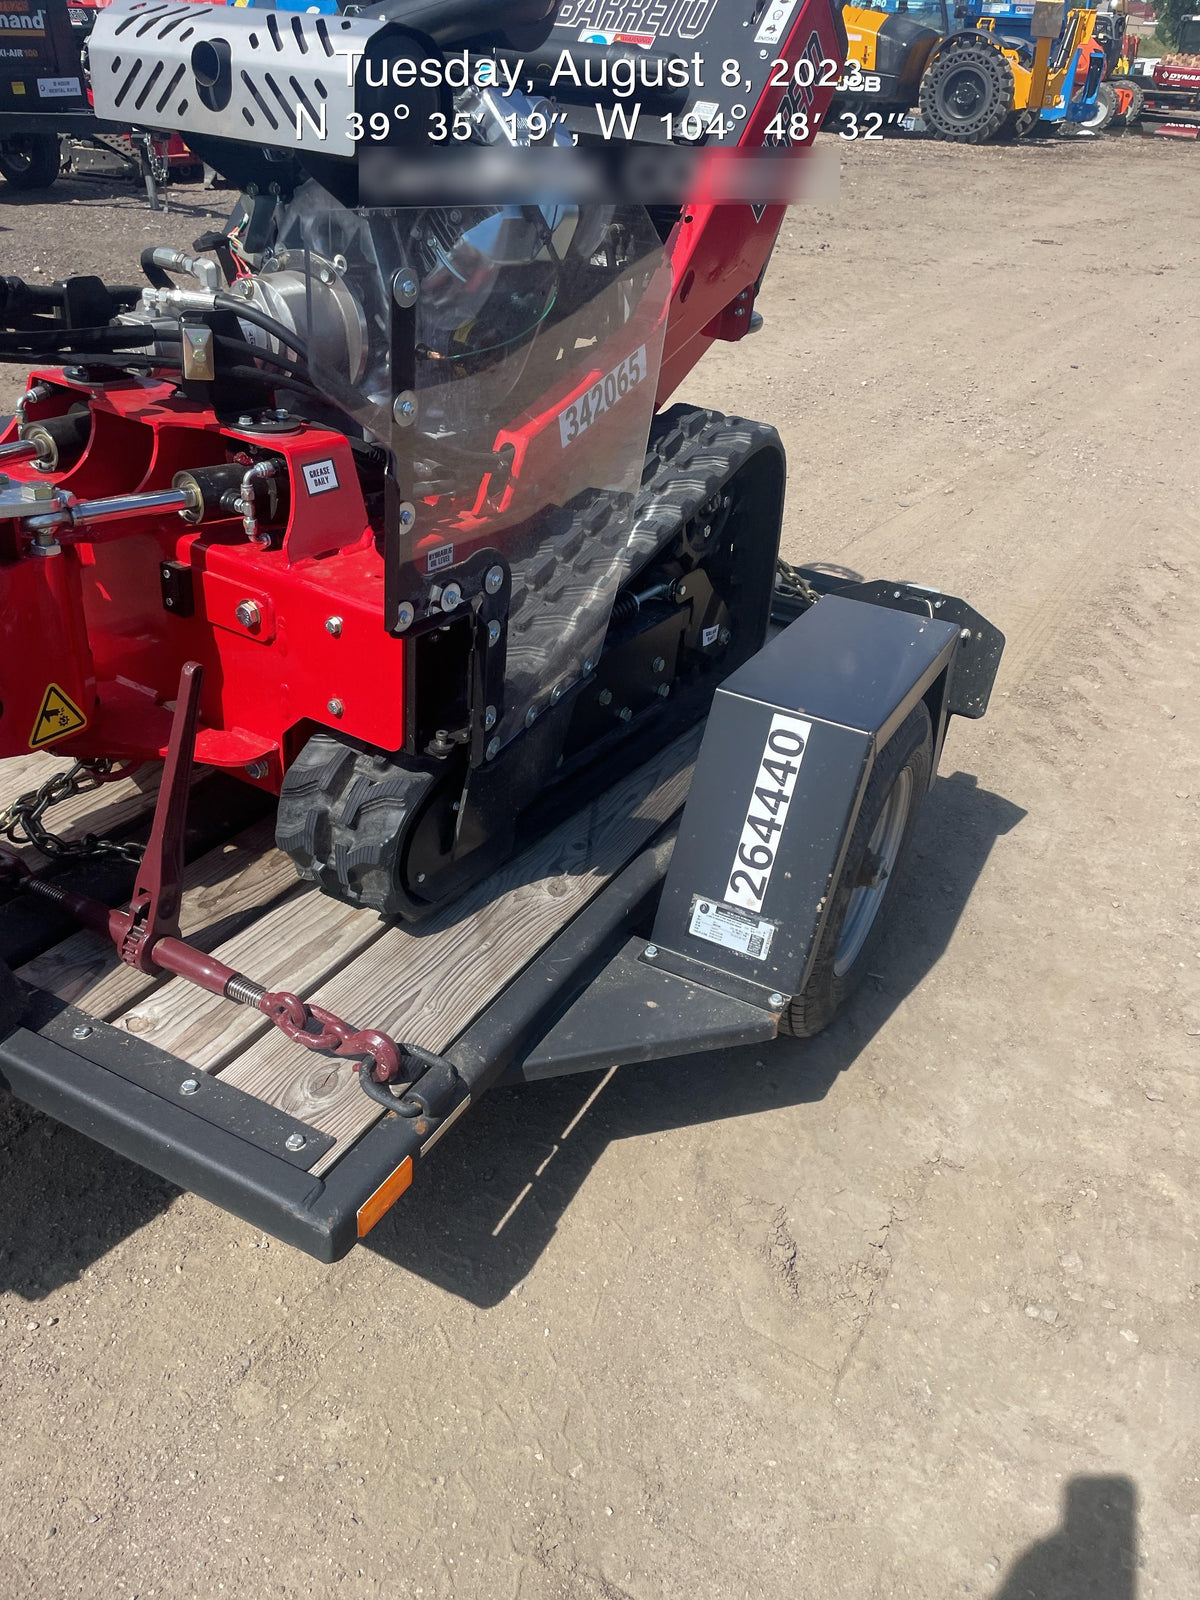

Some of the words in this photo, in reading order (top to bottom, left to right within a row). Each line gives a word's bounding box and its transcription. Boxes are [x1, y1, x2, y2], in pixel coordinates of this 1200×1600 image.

[565, 350, 641, 442] 342065
[308, 466, 331, 479] GREASE
[313, 475, 329, 487] DAILY
[729, 728, 805, 901] 264440
